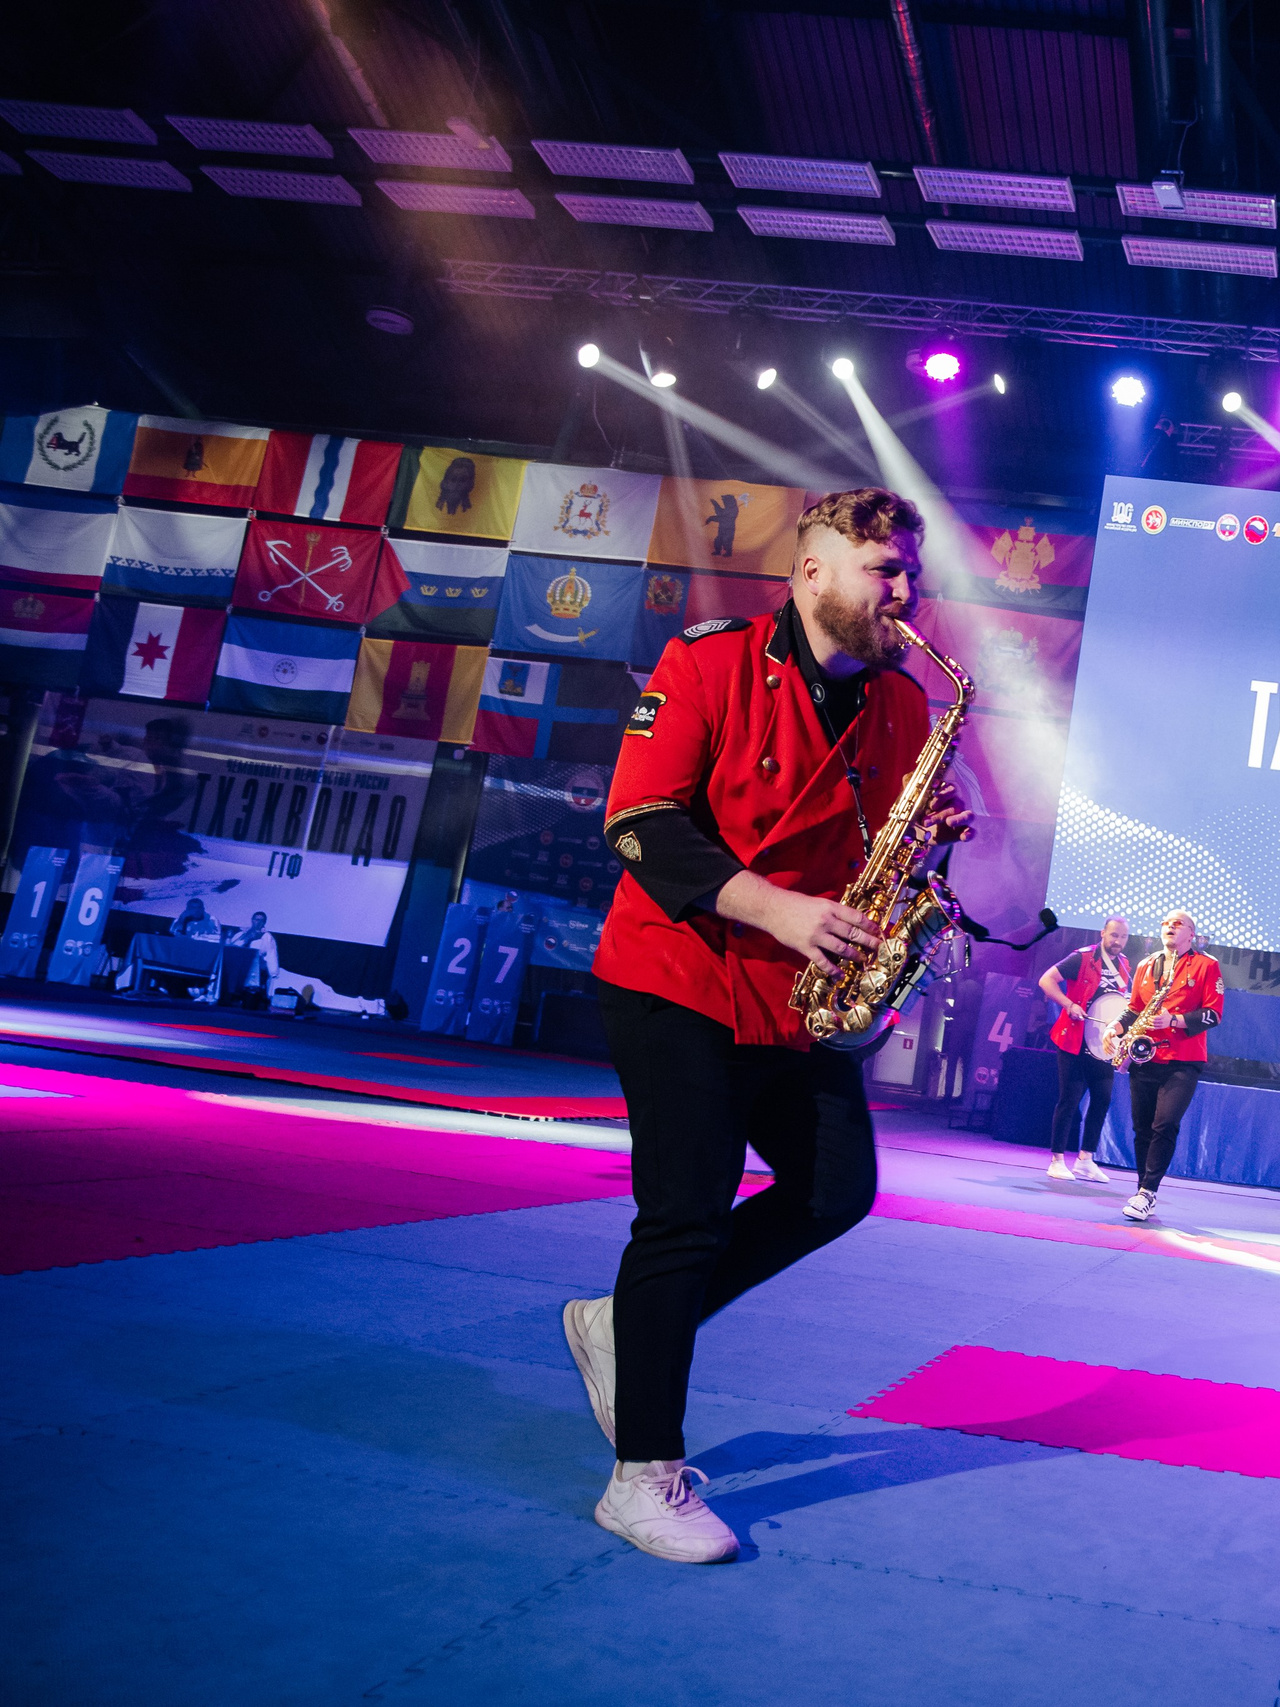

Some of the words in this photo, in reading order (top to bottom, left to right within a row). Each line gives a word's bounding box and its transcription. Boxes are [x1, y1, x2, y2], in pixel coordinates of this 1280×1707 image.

[187, 772, 407, 868] ТХЭКВОНДО
[267, 851, 304, 879] ГТФ
[30, 881, 47, 918] 1
[78, 887, 104, 926] 6
[446, 937, 473, 975] 2
[494, 945, 520, 984] 7
[987, 1010, 1014, 1053] 4
